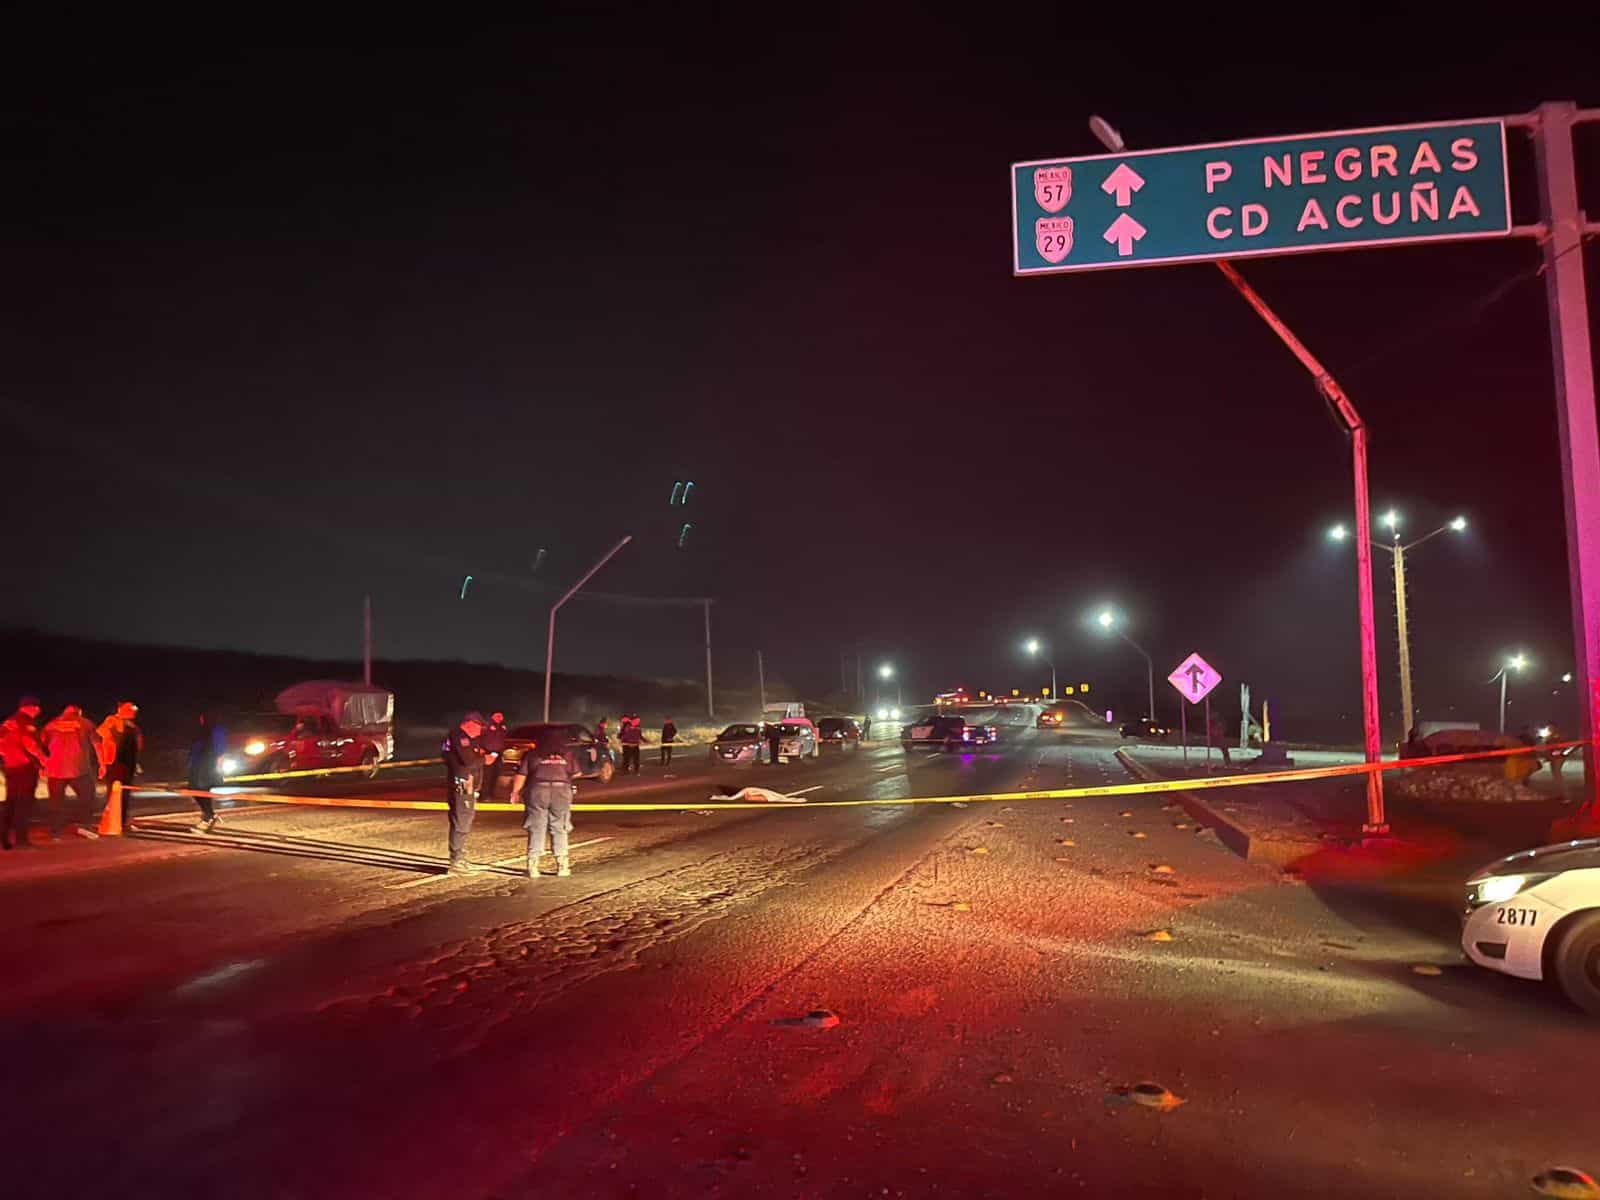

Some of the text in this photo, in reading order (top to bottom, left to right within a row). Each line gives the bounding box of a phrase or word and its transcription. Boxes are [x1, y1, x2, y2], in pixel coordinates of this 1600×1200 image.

[1205, 138, 1478, 193] P NEGRAS
[1043, 184, 1064, 203] 57
[1206, 181, 1480, 239] CD ACUÑA
[1044, 235, 1066, 253] 29
[1497, 907, 1537, 927] 2877
